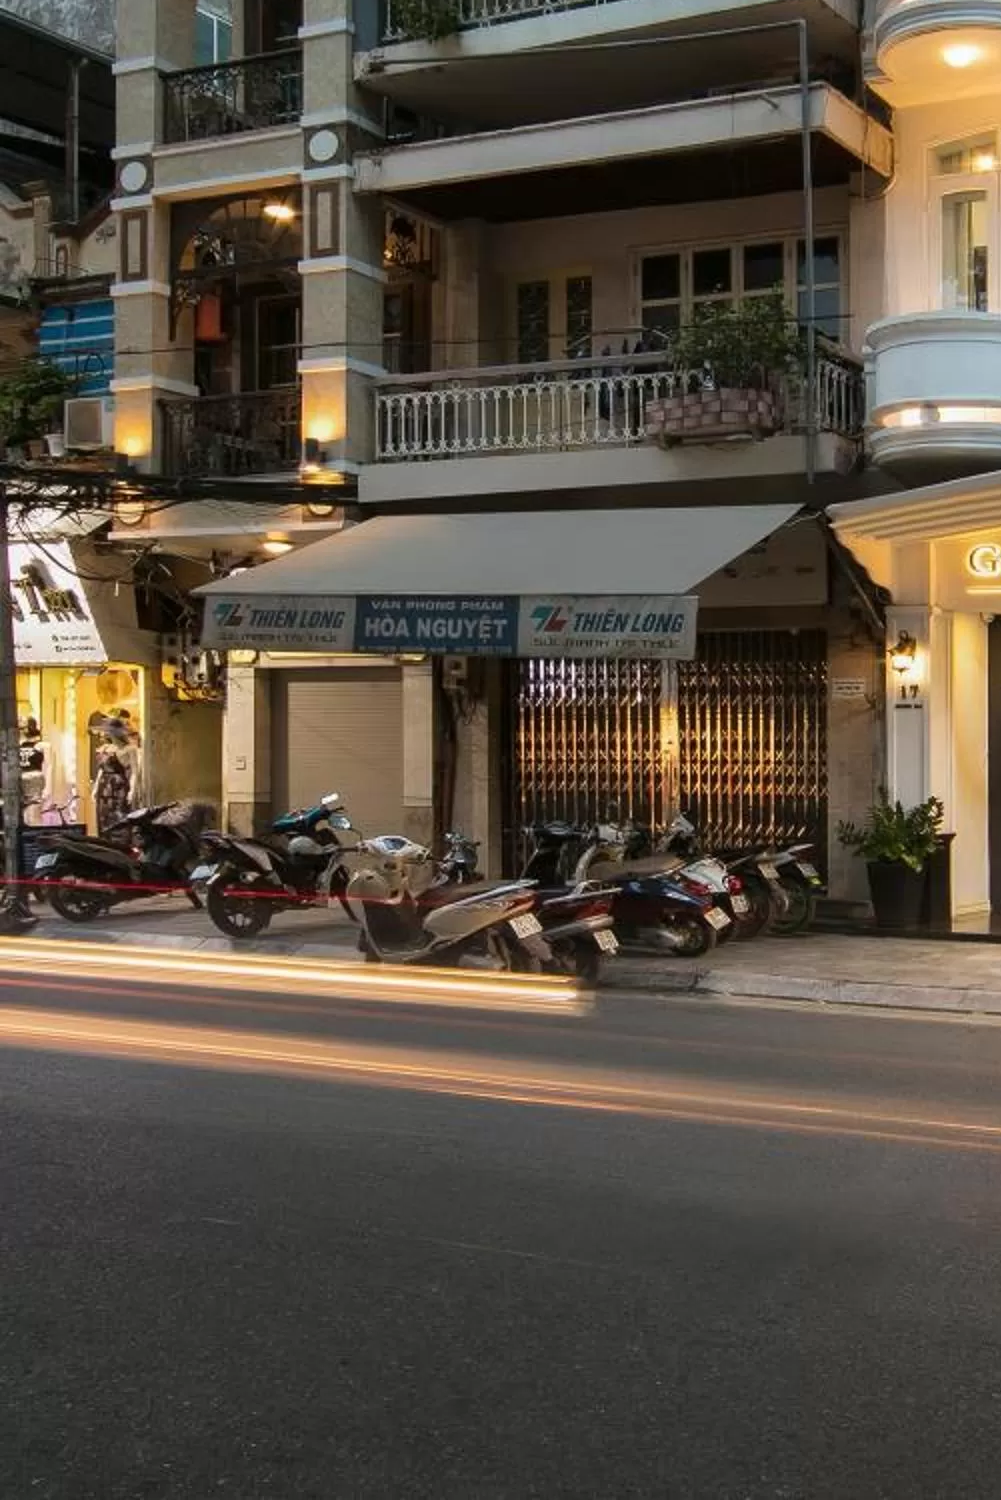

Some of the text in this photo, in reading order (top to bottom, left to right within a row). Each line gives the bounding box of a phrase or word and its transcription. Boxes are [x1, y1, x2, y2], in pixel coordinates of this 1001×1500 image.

[302, 611, 346, 629] LONG
[364, 614, 410, 637] HÒA
[416, 614, 508, 644] NGUYỆT
[630, 613, 685, 633] LONG
[901, 684, 919, 699] 17
